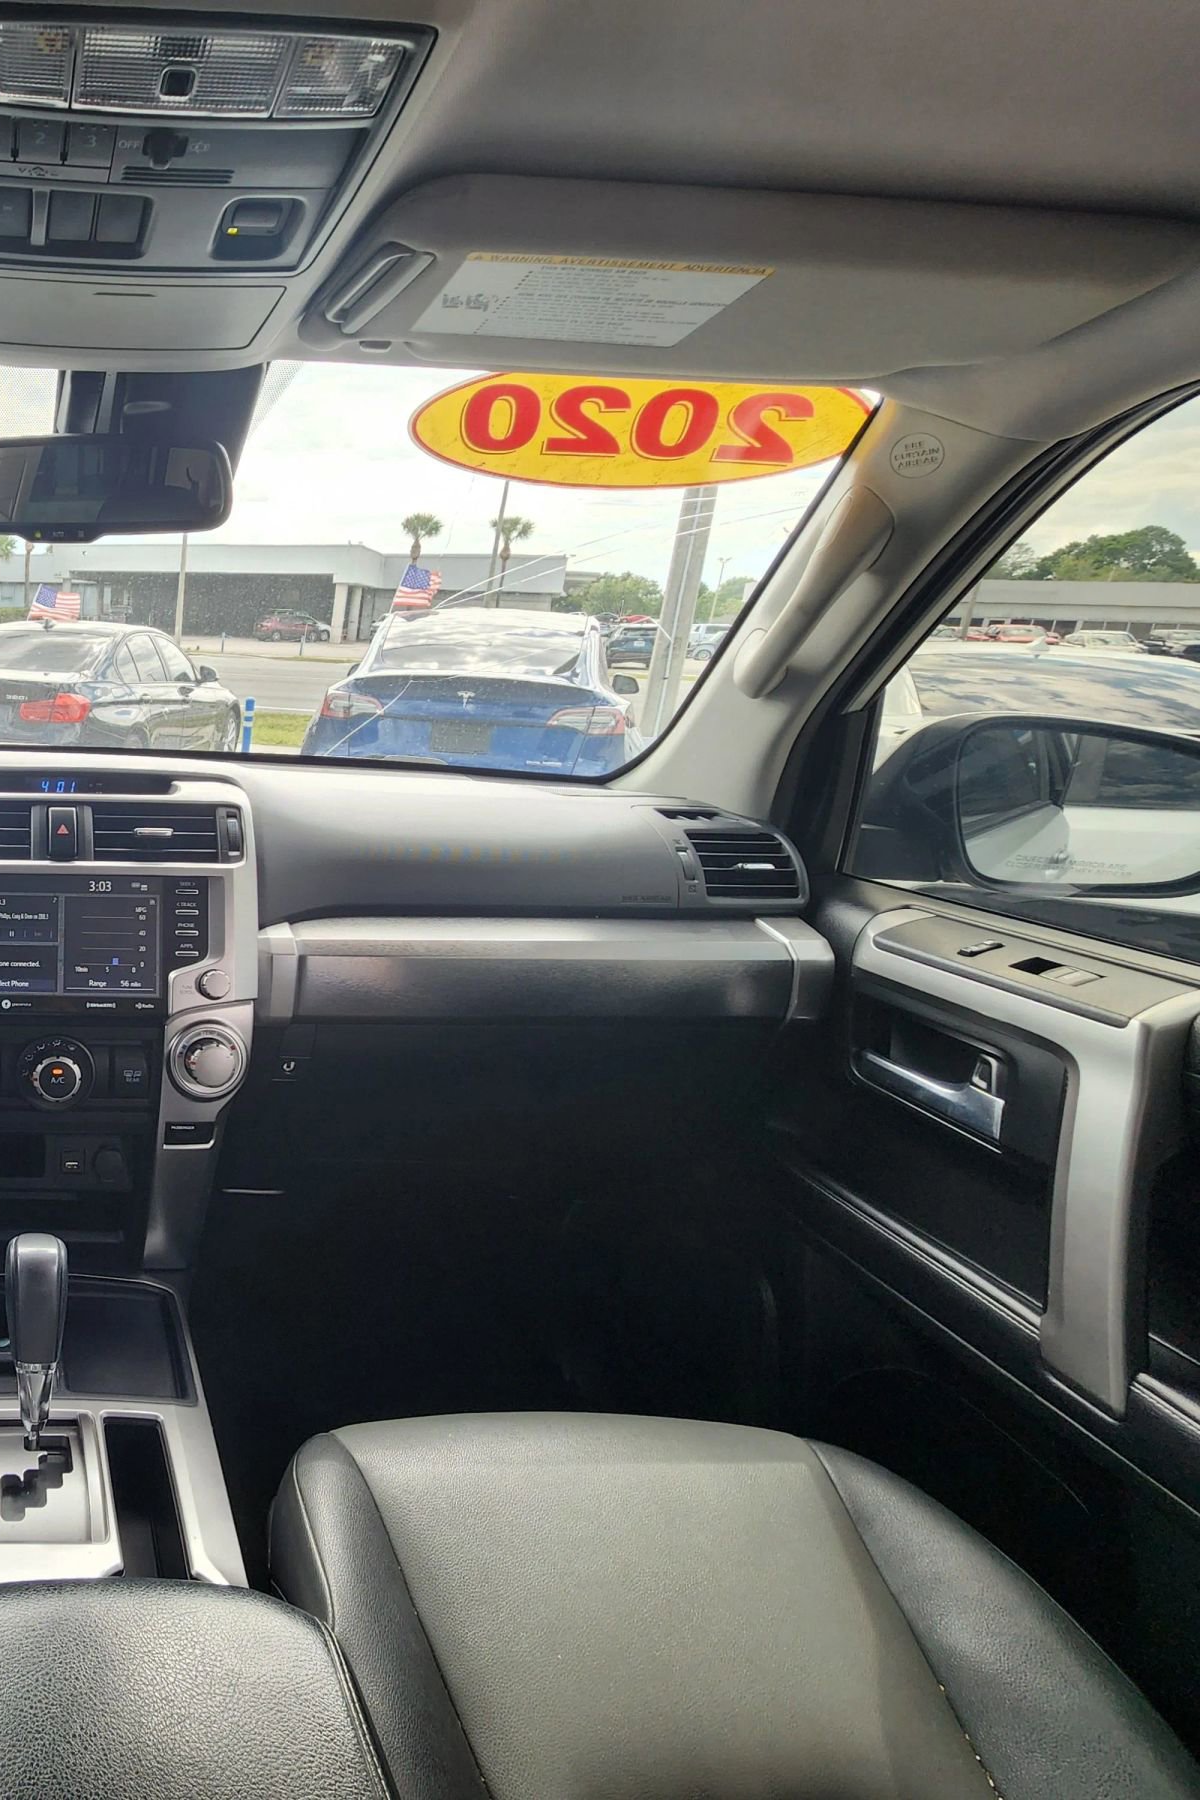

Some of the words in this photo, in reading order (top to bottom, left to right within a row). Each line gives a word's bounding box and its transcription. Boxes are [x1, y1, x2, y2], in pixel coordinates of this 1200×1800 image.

[34, 132, 46, 145] 2
[87, 135, 97, 147] 3
[118, 139, 141, 149] OFF
[88, 881, 112, 892] 3:03
[9, 960, 41, 968] connected.
[10, 979, 29, 988] Phone
[88, 979, 107, 988] Range
[120, 979, 129, 987] 56
[50, 1076, 65, 1084] A/C
